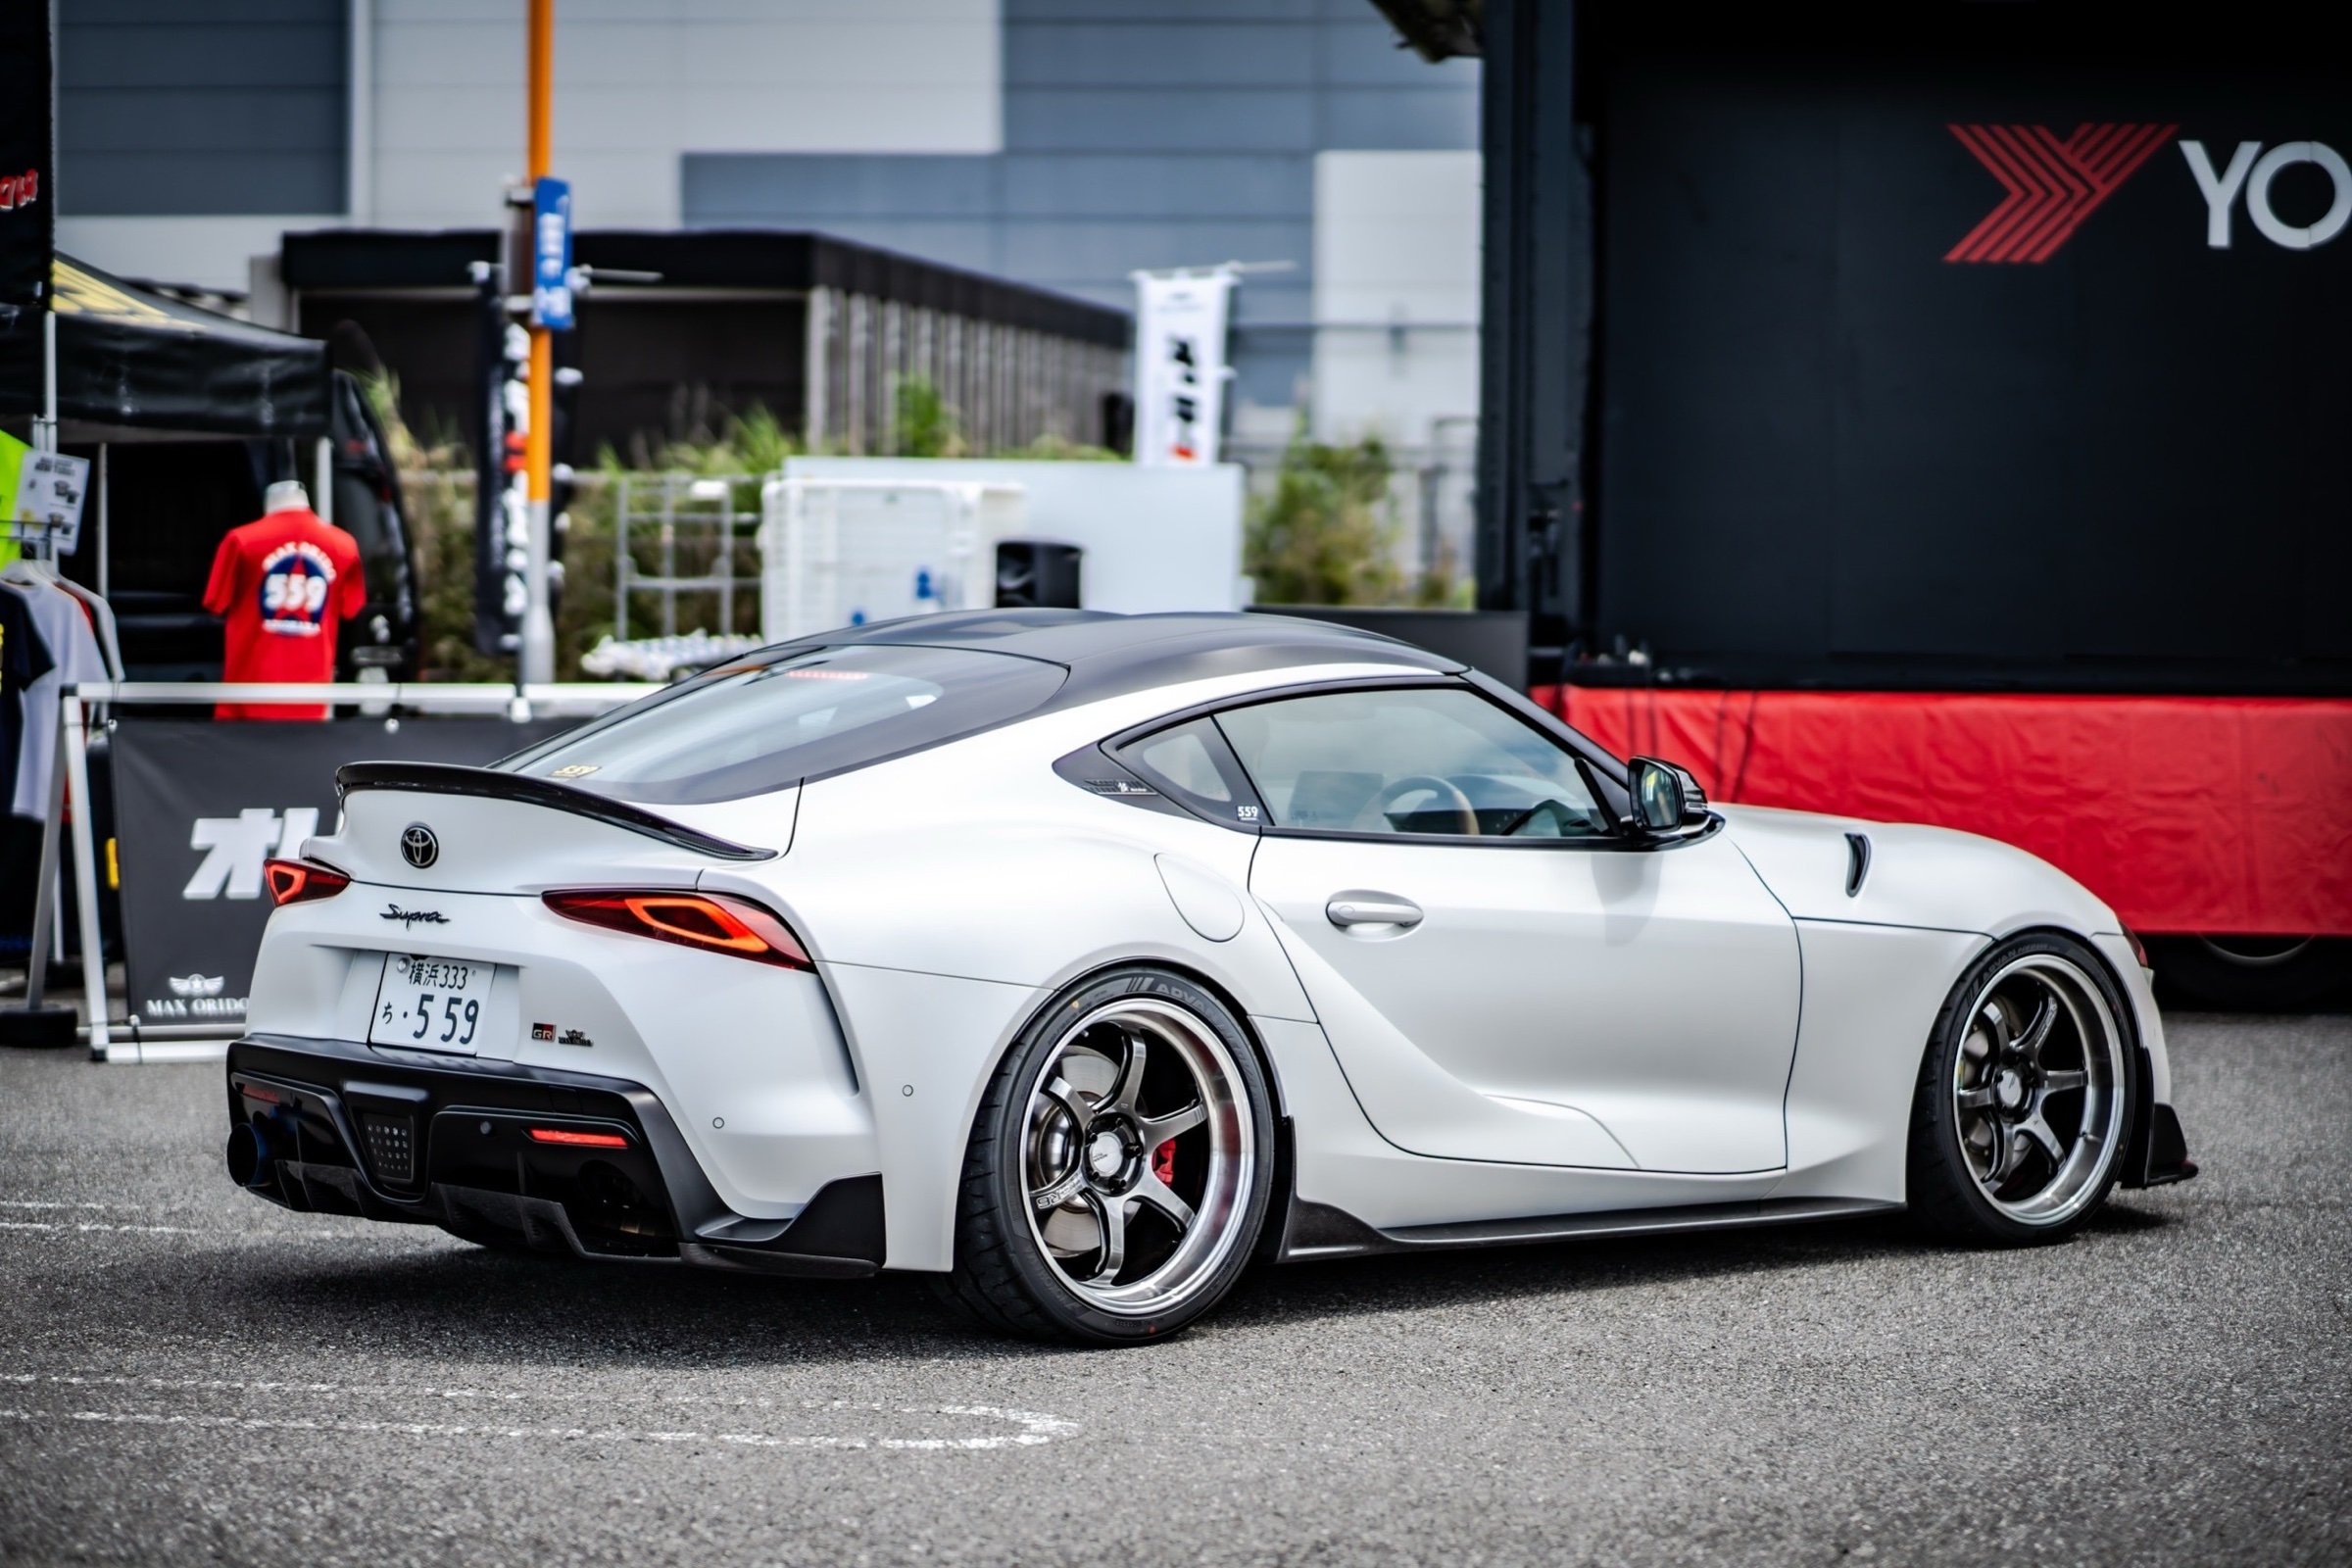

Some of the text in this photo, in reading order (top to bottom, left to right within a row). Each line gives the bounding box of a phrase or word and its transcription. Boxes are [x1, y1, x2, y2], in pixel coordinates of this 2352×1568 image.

[2179, 140, 2352, 251] YO
[264, 573, 327, 612] 559
[1237, 806, 1258, 817] 559
[379, 903, 451, 931] Supra
[145, 998, 250, 1017] MAX ORIDO
[382, 1001, 393, 1025] ち
[533, 1029, 553, 1040] GR
